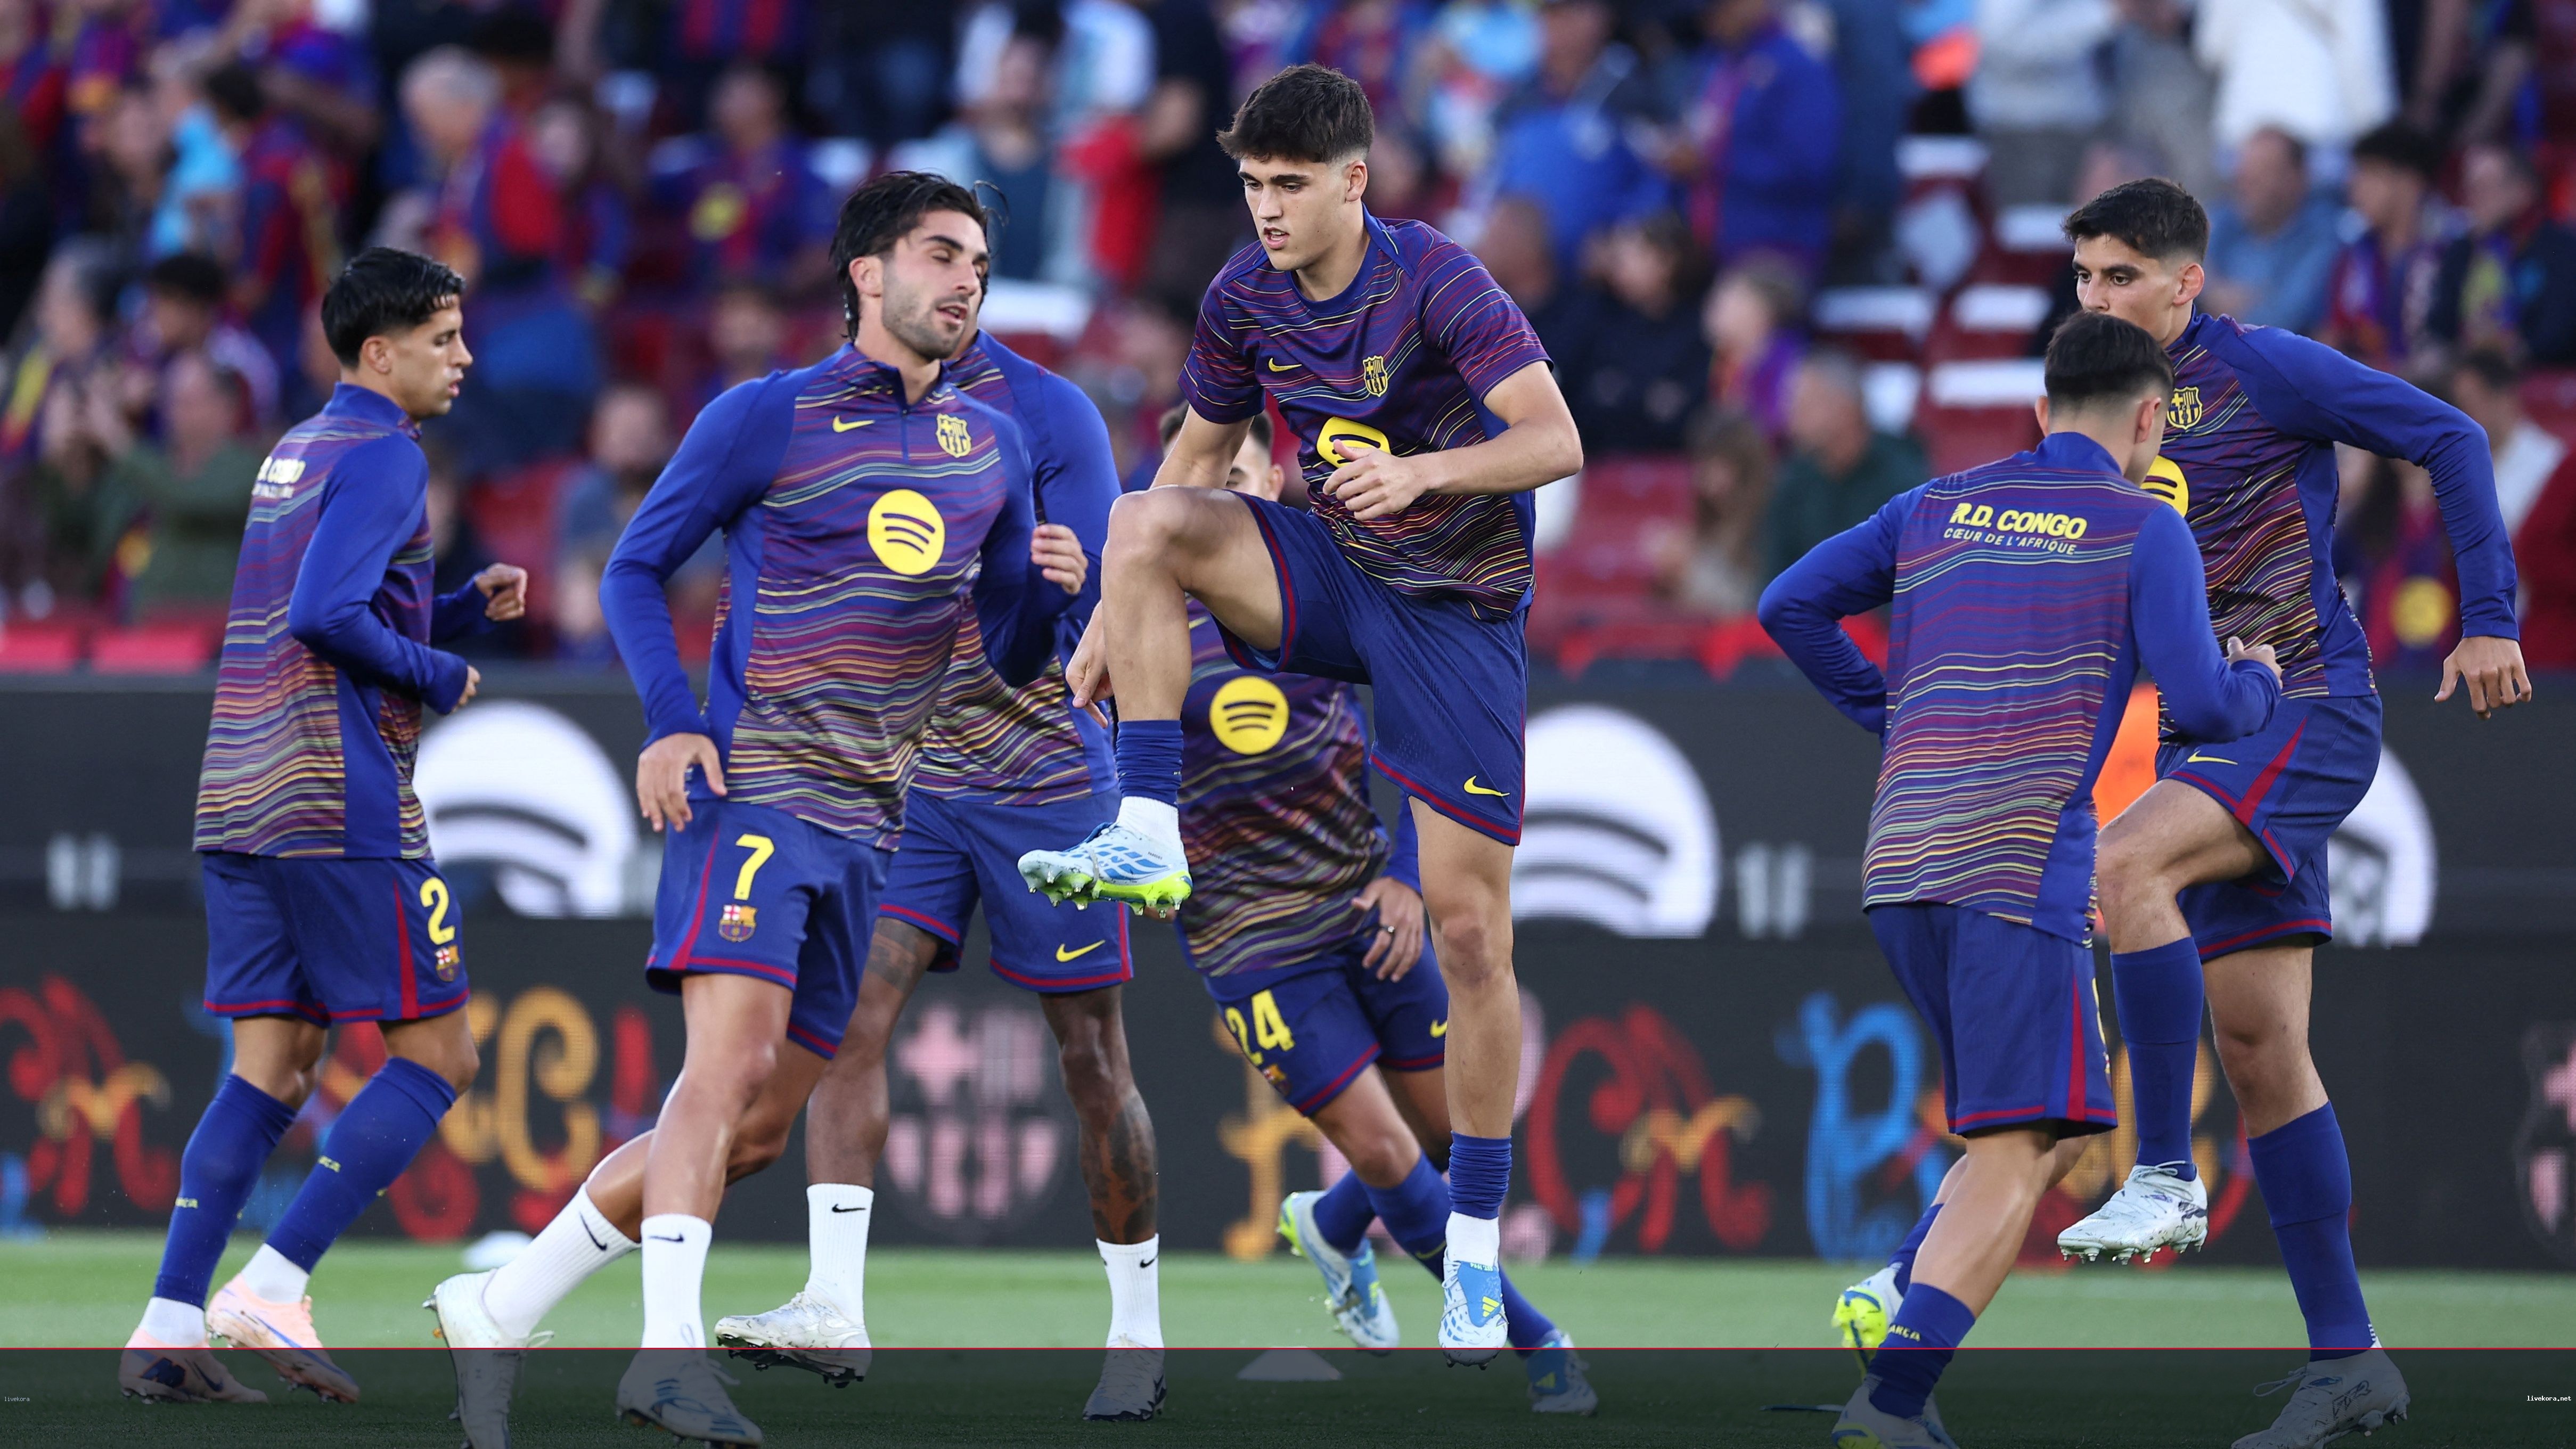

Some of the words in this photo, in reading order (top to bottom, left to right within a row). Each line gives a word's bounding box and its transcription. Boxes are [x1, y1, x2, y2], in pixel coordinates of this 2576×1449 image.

[1949, 503, 1994, 528] R.D.
[1997, 510, 2088, 539] CONGO
[1984, 534, 2005, 546] DE
[2006, 536, 2077, 555] L'AFRIQUE
[735, 833, 774, 900] 7
[420, 877, 455, 945] 2
[1225, 989, 1295, 1066] 24
